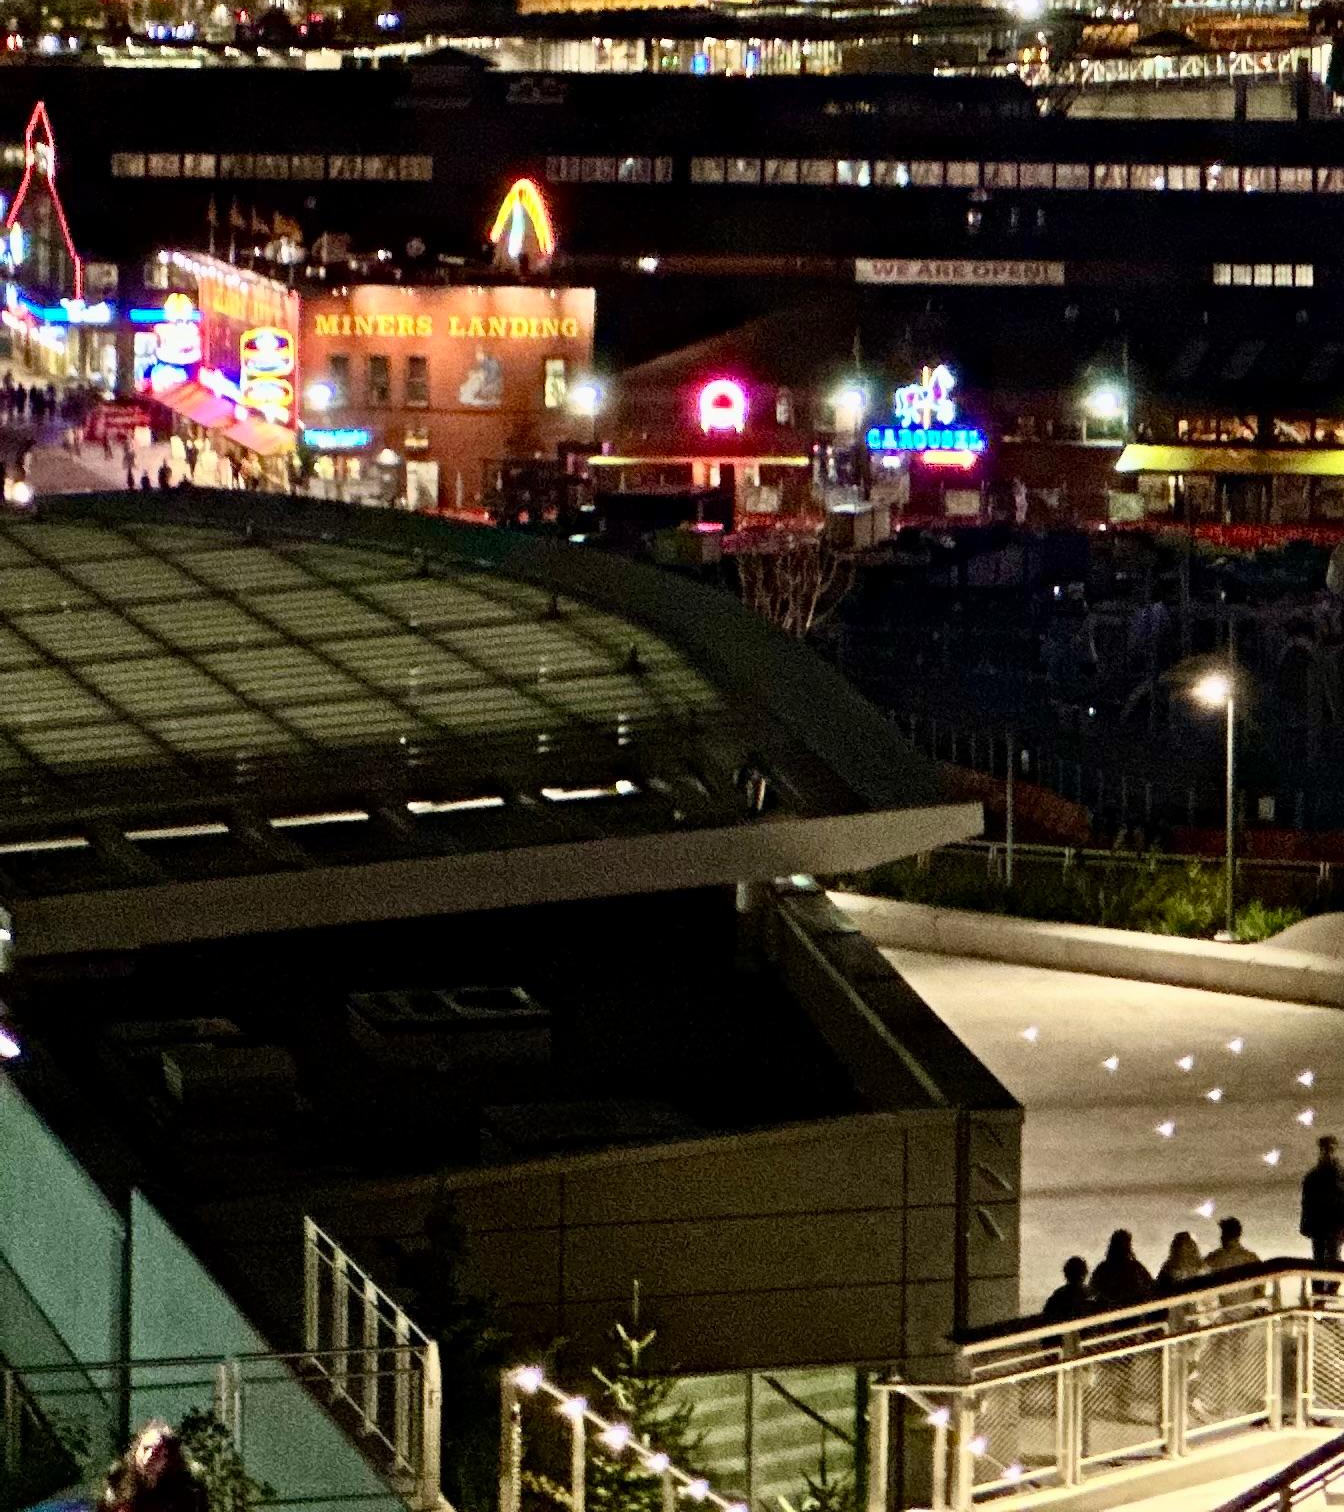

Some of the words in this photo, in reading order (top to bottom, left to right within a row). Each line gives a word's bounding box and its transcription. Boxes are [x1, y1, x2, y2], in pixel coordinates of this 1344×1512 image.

[872, 259, 911, 279] WE
[917, 260, 966, 279] ARE
[314, 313, 433, 338] MINERS
[447, 314, 579, 339] LANDING
[867, 427, 984, 450] CAROUSEL
